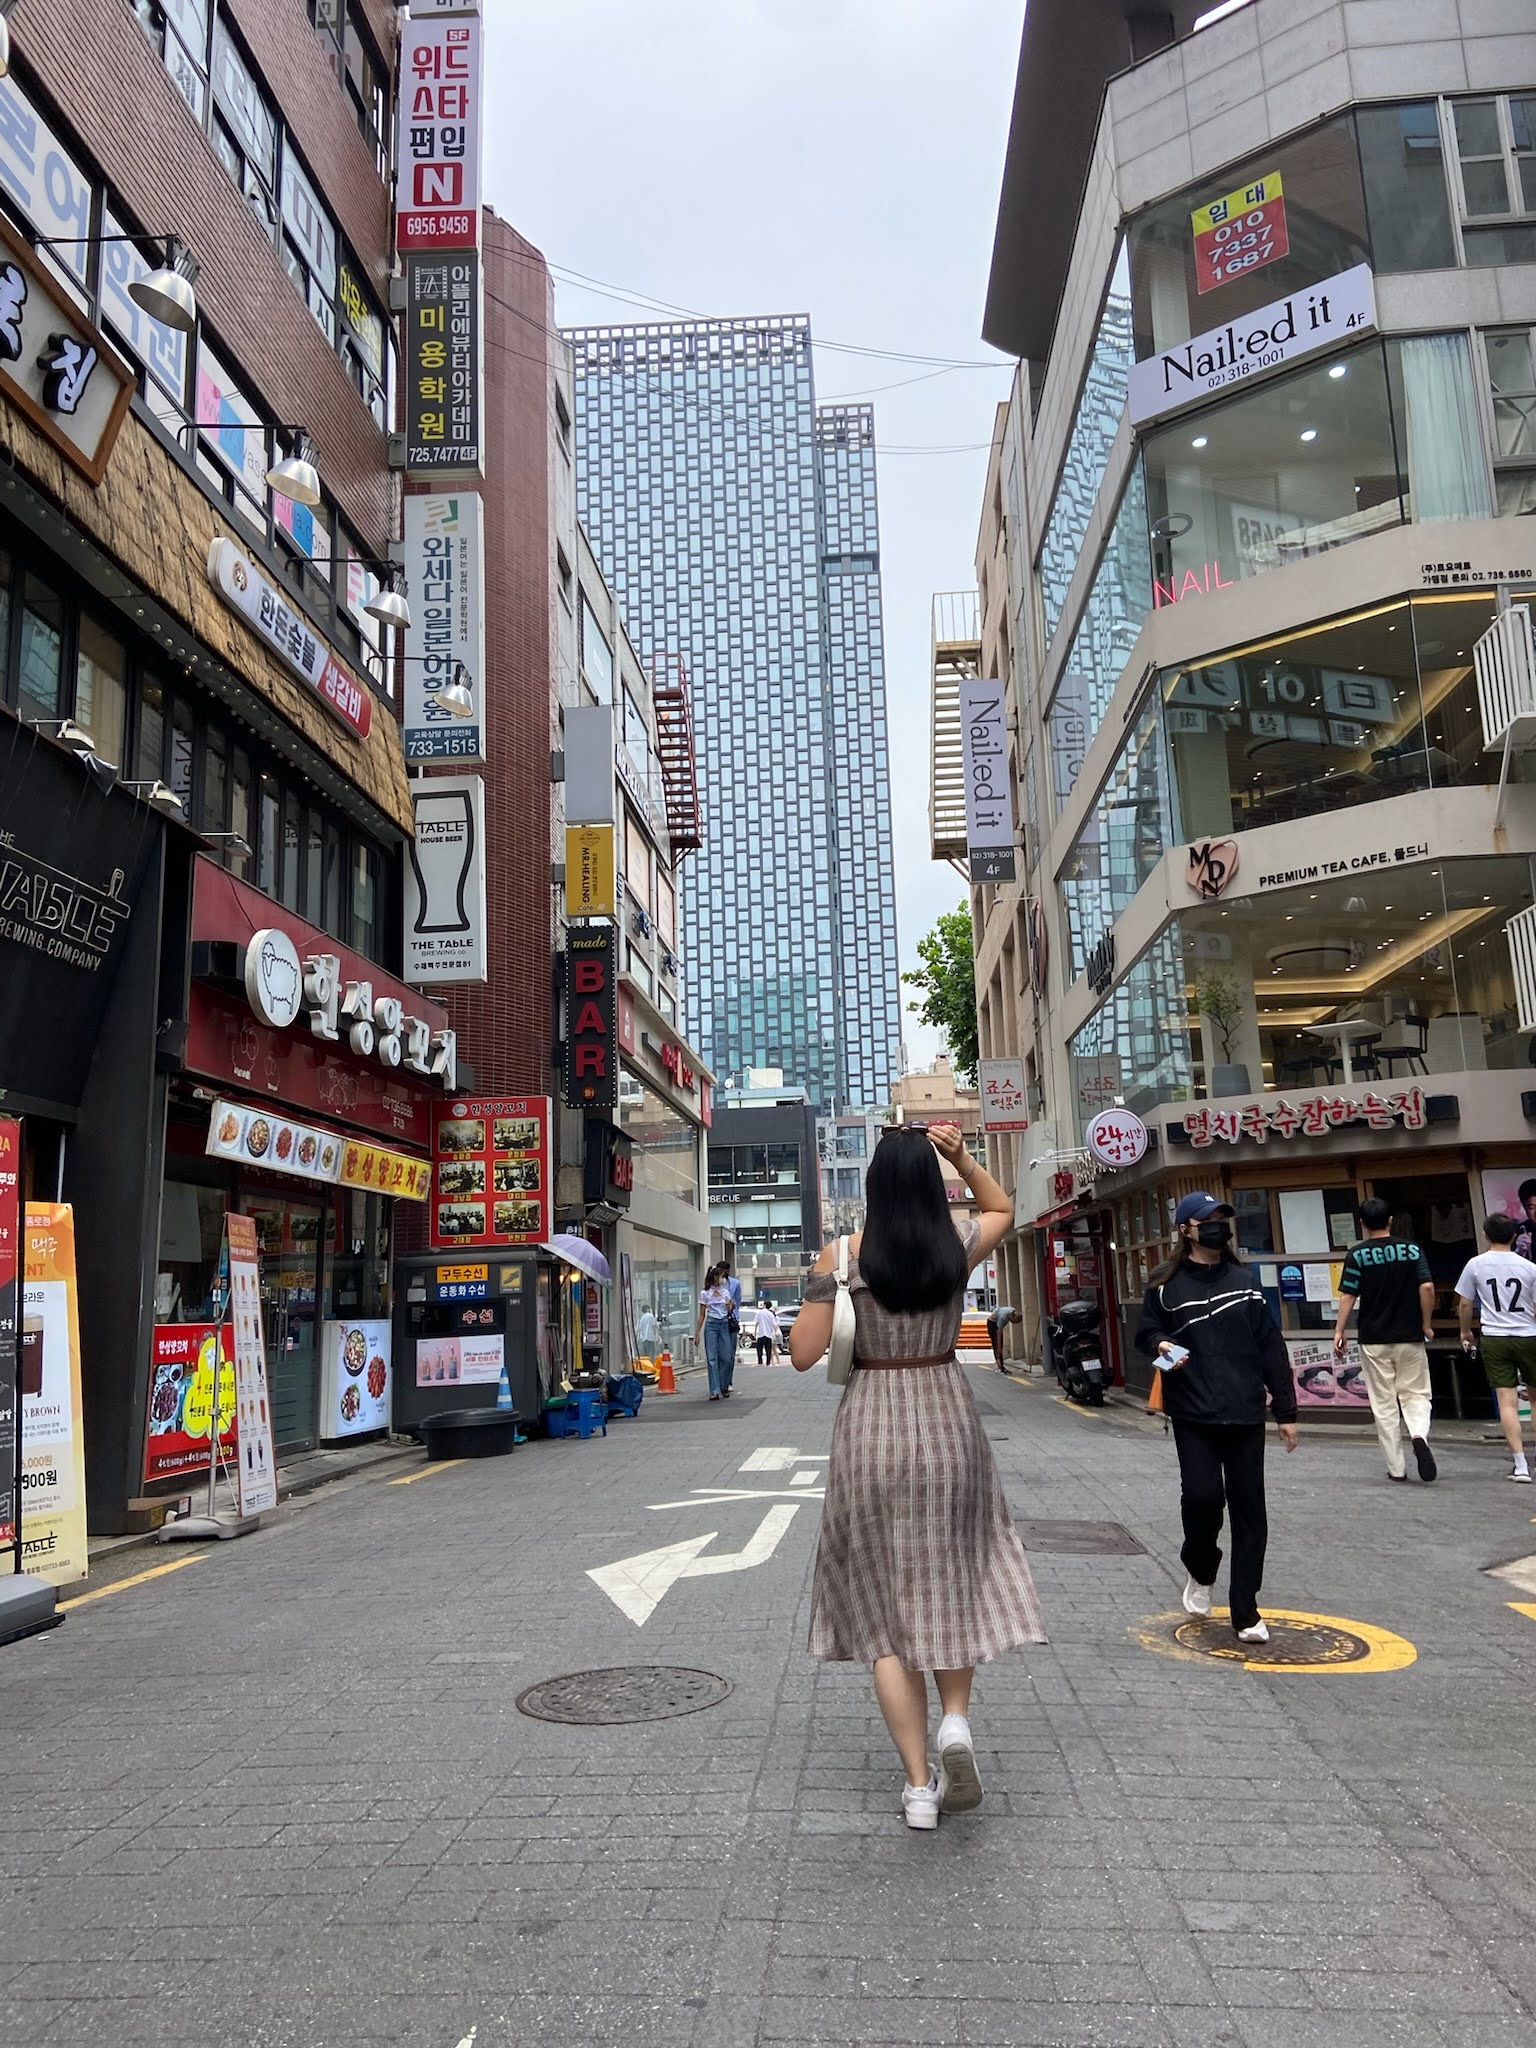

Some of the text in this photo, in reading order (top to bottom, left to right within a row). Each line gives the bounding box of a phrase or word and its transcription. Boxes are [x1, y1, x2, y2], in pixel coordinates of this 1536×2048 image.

[412, 45, 469, 79] 위드
[412, 85, 469, 120] 스타
[410, 126, 465, 158] 편입
[407, 216, 469, 236] 6956.9458
[1213, 210, 1264, 243] 010
[1208, 224, 1273, 264] 7337
[1211, 242, 1274, 281] 1687
[1161, 295, 1365, 393] Nail:ed it 4F
[418, 306, 447, 440] 미용학원
[1228, 347, 1286, 380] 318-1001
[409, 447, 459, 463] 725.7477
[1154, 560, 1233, 609] NAIL
[260, 587, 362, 723] 한돈숯불 생갈비
[408, 739, 477, 756] 733-1515
[968, 698, 1006, 828] Nail:ed it
[420, 835, 463, 844] HOUSE BEER
[983, 850, 1014, 860] 318-1001
[581, 847, 591, 903] MR.HEALING
[986, 865, 1001, 875] 4F
[1259, 865, 1318, 887] PREMIUM
[1321, 860, 1348, 875] TEA
[47, 938, 101, 972] COMPANY
[411, 940, 434, 950] THE
[572, 935, 608, 949] made
[302, 954, 457, 1090] 한성양꼬치
[574, 960, 607, 1078] BAR
[985, 1079, 1016, 1094] 죠스
[471, 1102, 526, 1115] 한성양꼬치
[991, 1096, 1022, 1111] 떡볶이
[1185, 1087, 1425, 1147] 멸치국수잘하는집
[1096, 1125, 1142, 1146] 24시간
[1108, 1143, 1137, 1161] 영업
[613, 1153, 633, 1192] BAR
[708, 1194, 741, 1203] BECUE
[32, 1237, 57, 1259] 맥주
[441, 1267, 483, 1281] 구두수선
[1486, 1277, 1525, 1312] 12
[462, 1309, 494, 1324] 수선
